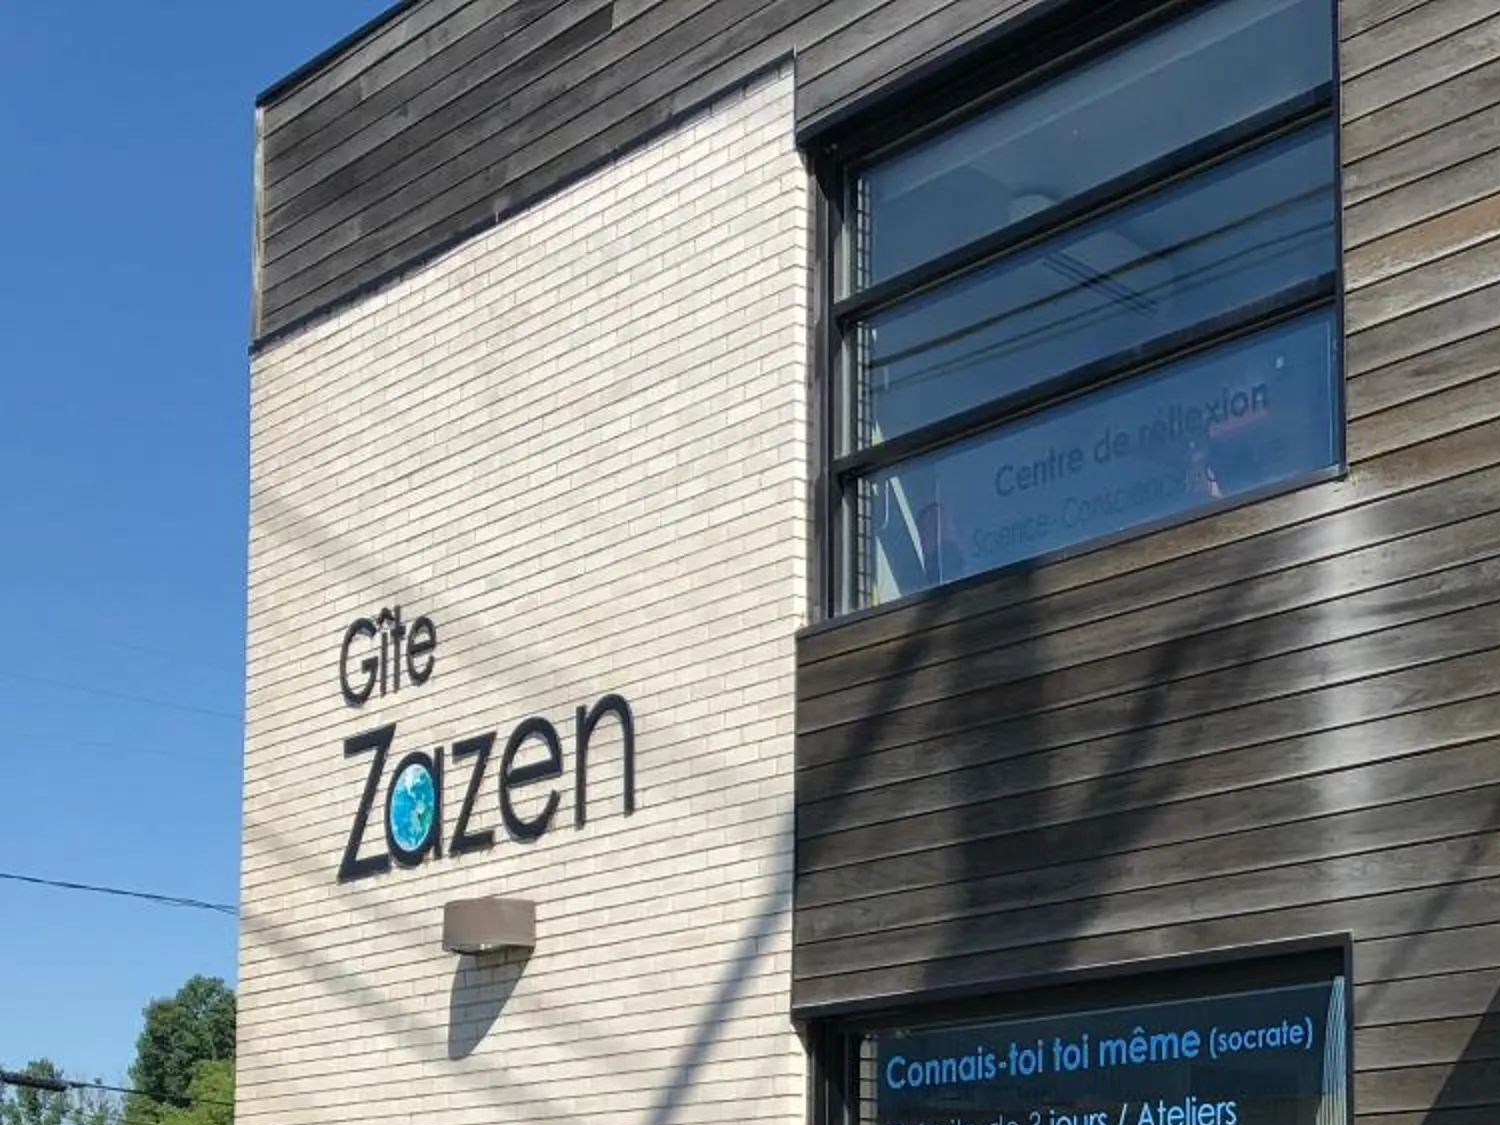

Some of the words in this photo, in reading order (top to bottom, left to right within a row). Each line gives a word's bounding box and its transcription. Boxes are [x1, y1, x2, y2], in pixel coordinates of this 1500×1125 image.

[994, 445, 1084, 498] Centre
[1094, 425, 1130, 465] de
[340, 607, 437, 706] Gîte
[337, 693, 635, 884] Zazen
[886, 1038, 1043, 1089] Connais-toi
[1054, 1033, 1089, 1071] toi
[1100, 1026, 1201, 1067] même
[1209, 1016, 1314, 1059] (socrate)
